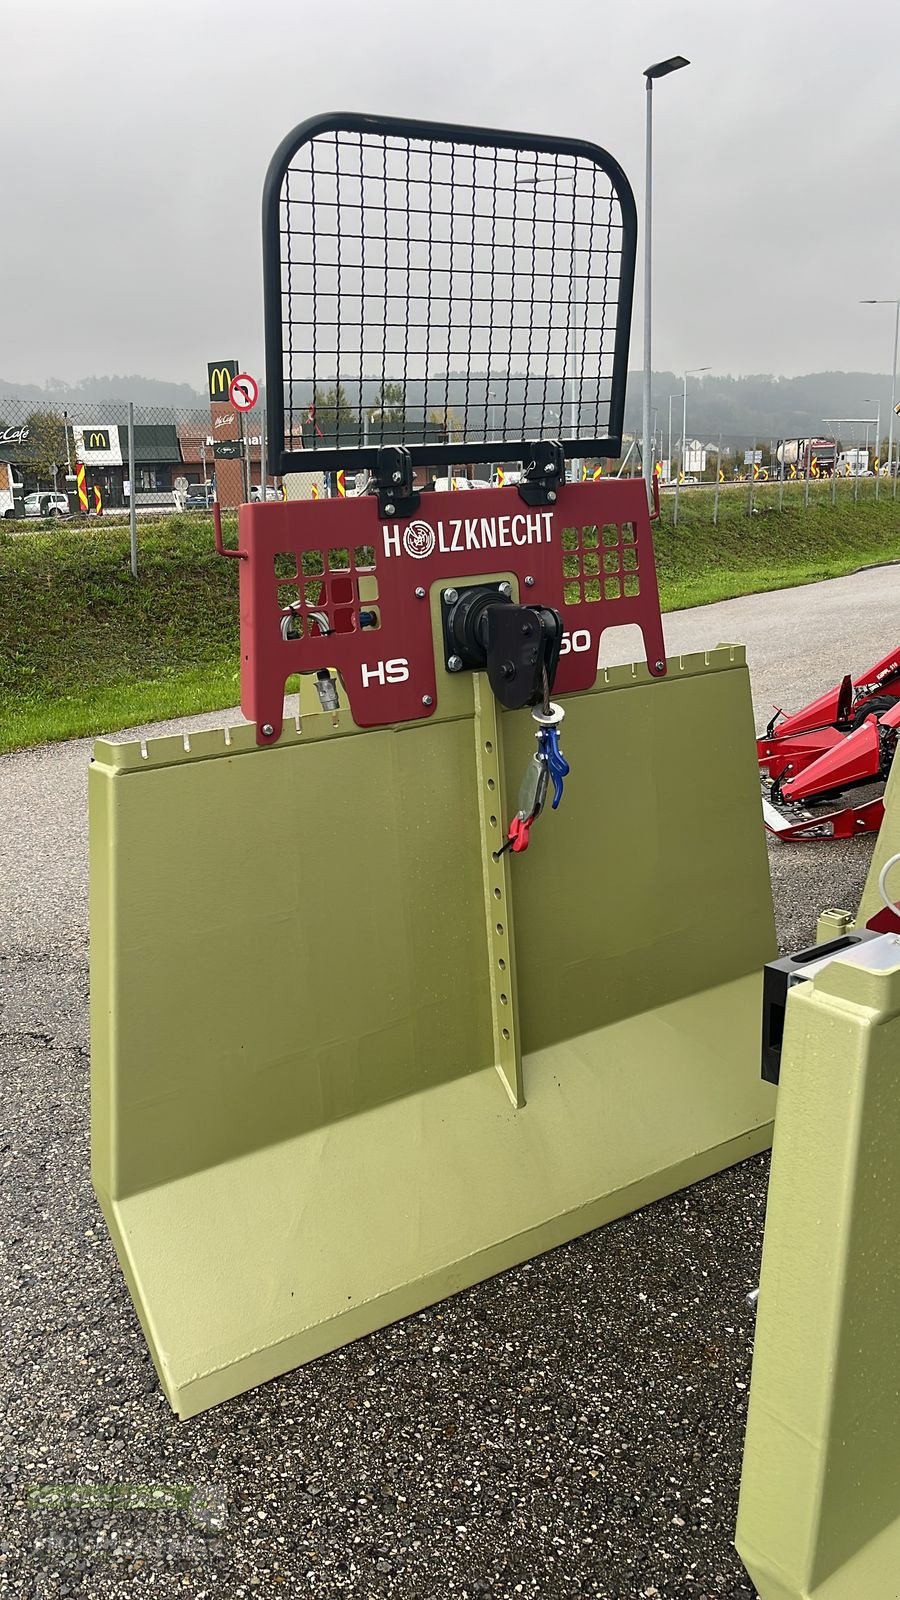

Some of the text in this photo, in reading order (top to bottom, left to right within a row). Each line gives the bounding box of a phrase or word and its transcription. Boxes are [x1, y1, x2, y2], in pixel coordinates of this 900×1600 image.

[383, 512, 553, 559] HOLZKNECHT
[361, 630, 591, 687] HS 50
